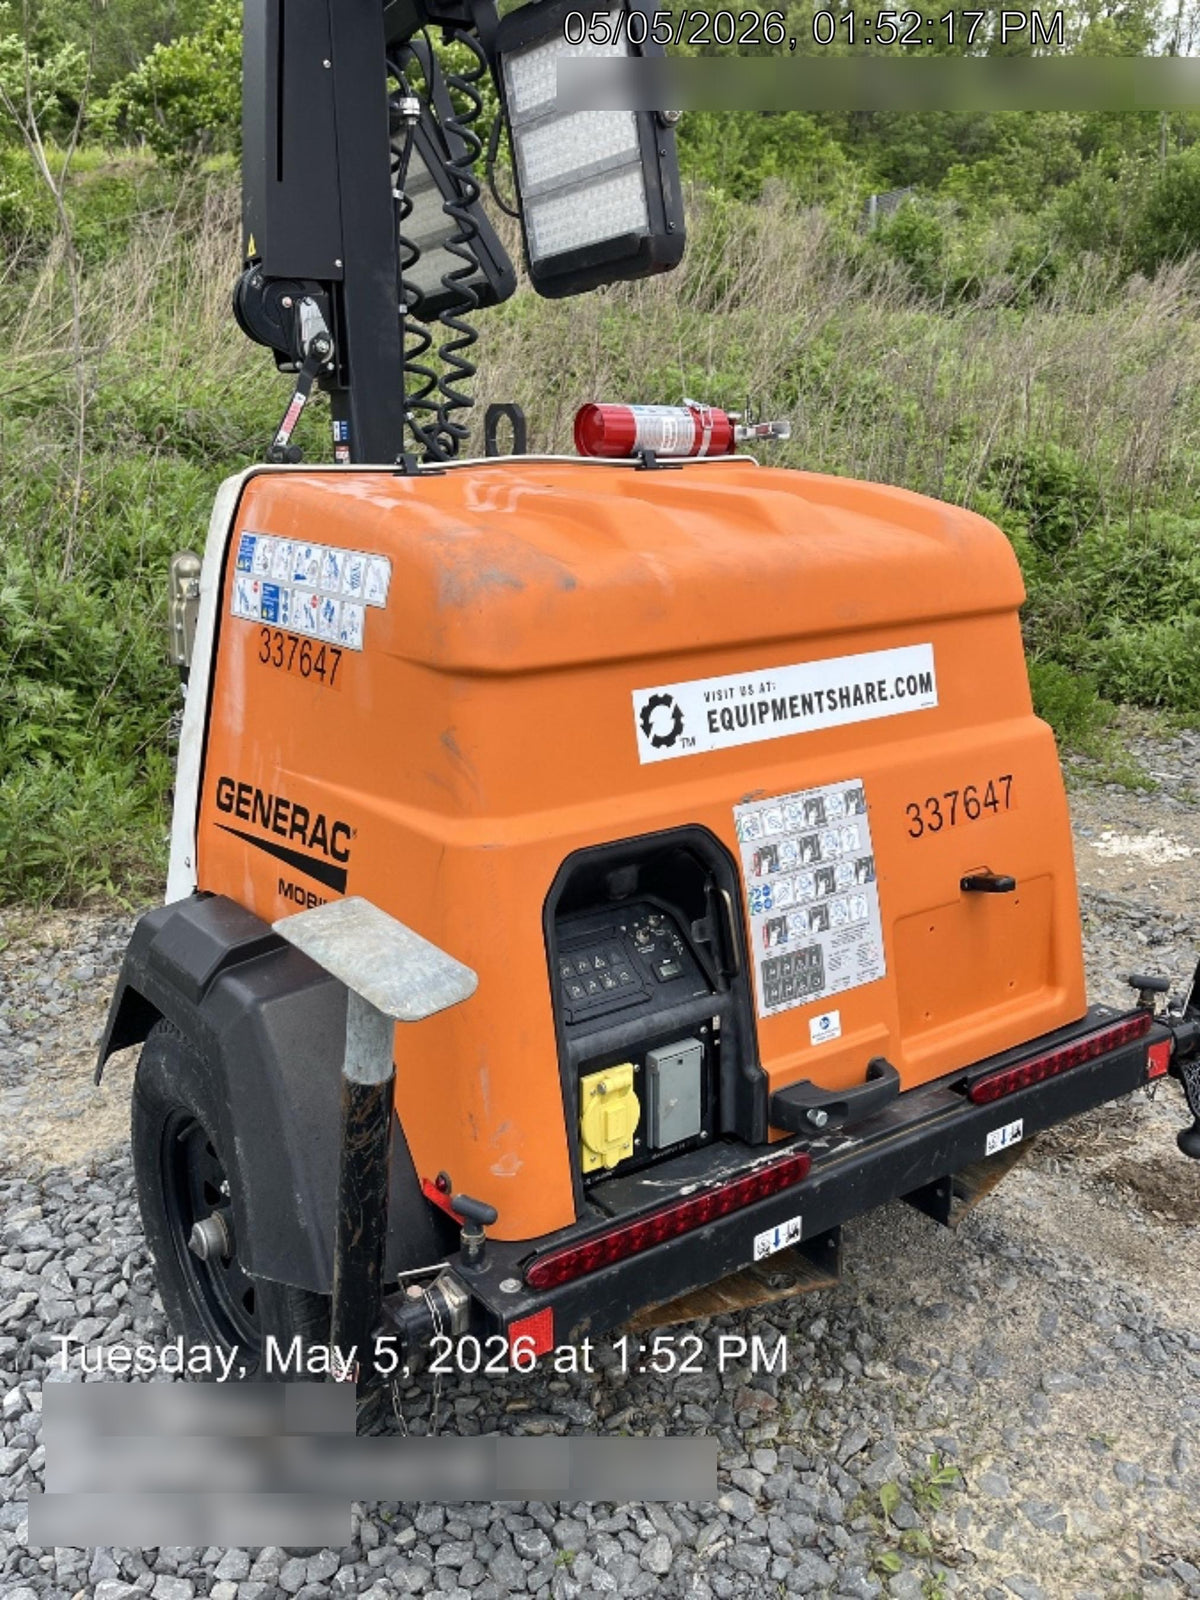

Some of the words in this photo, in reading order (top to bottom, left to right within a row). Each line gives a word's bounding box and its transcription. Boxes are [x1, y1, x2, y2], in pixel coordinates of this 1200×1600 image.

[259, 628, 342, 685] 337647
[704, 687, 734, 703] VISIT
[740, 684, 754, 696] US
[759, 680, 776, 694] AT:
[706, 671, 933, 733] EQUIPMENTSHARE.COM
[216, 776, 351, 863] GENERAC
[906, 775, 1013, 838] 337647
[278, 877, 327, 909] MOB
